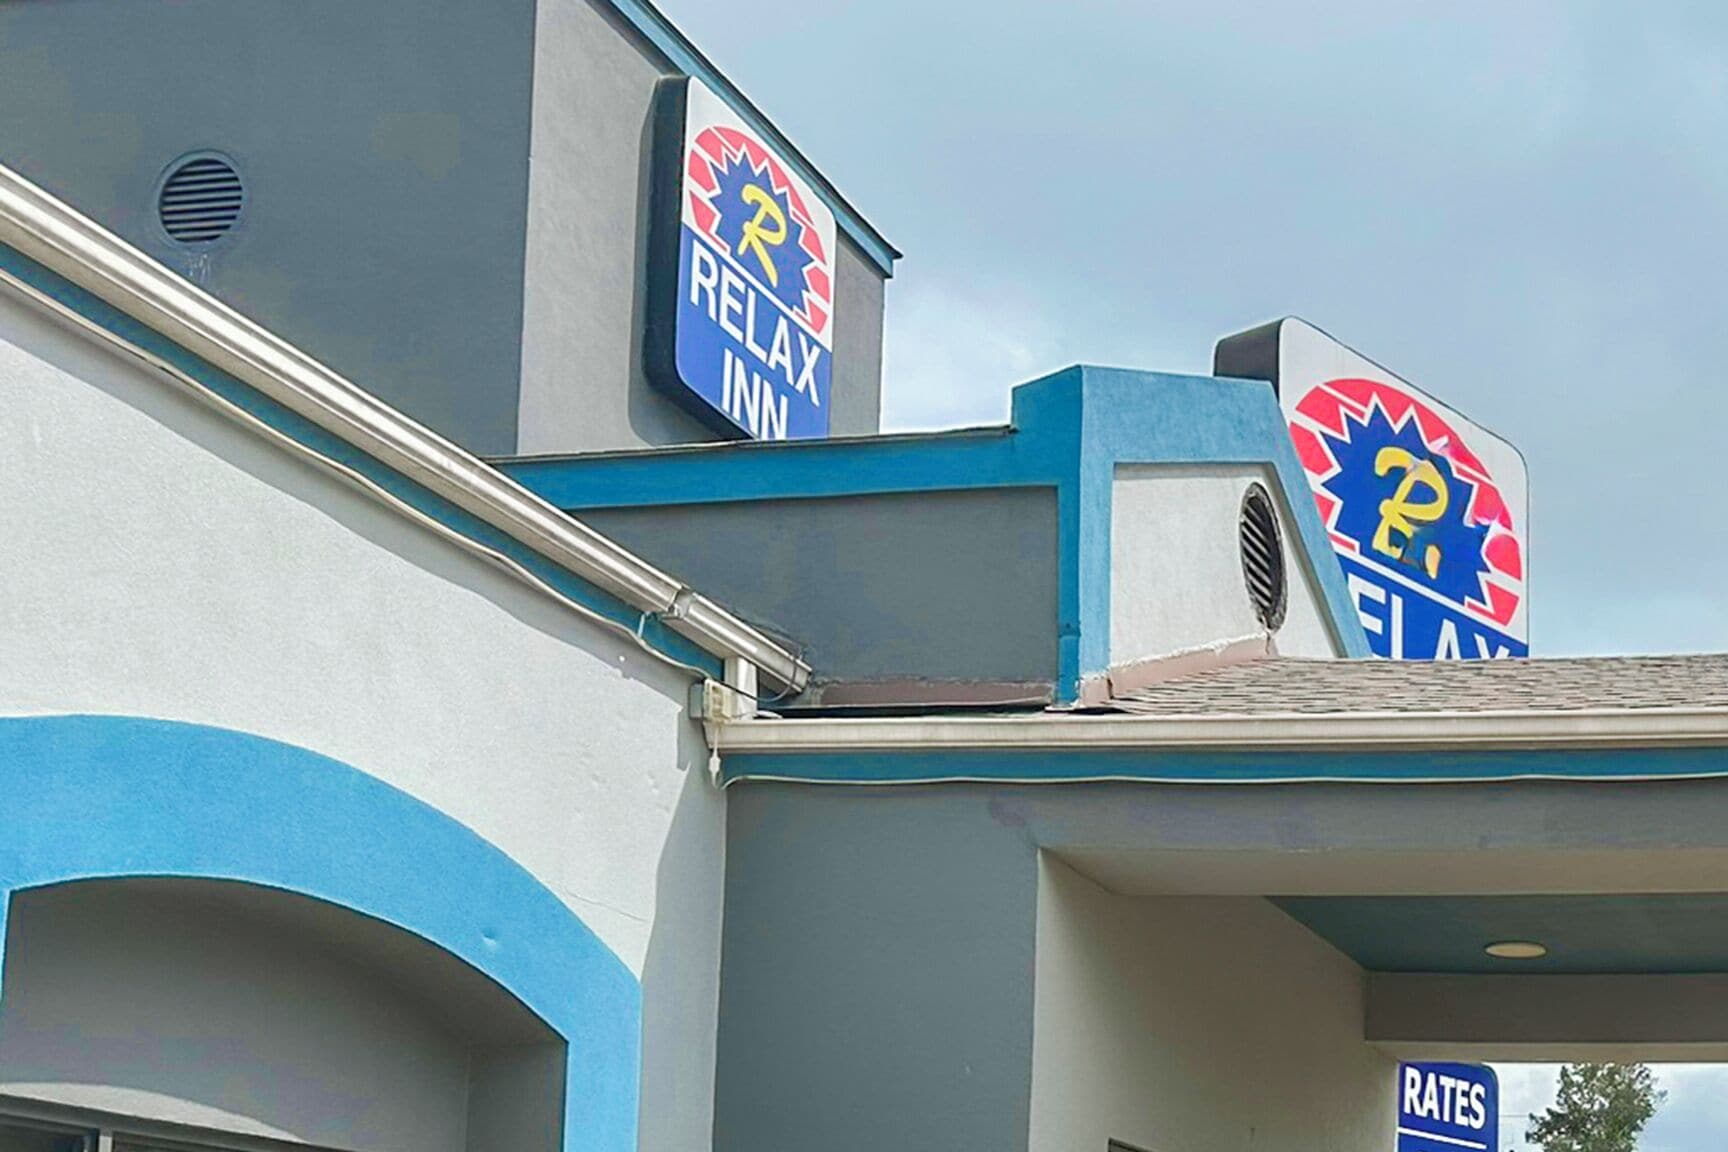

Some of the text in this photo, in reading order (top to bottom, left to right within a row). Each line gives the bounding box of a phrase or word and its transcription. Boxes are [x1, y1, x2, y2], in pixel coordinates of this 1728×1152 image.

[738, 183, 786, 288] R
[689, 239, 821, 408] RELAX
[722, 347, 789, 440] INN
[1348, 573, 1510, 660] ELA
[1404, 1066, 1486, 1130] RATES
